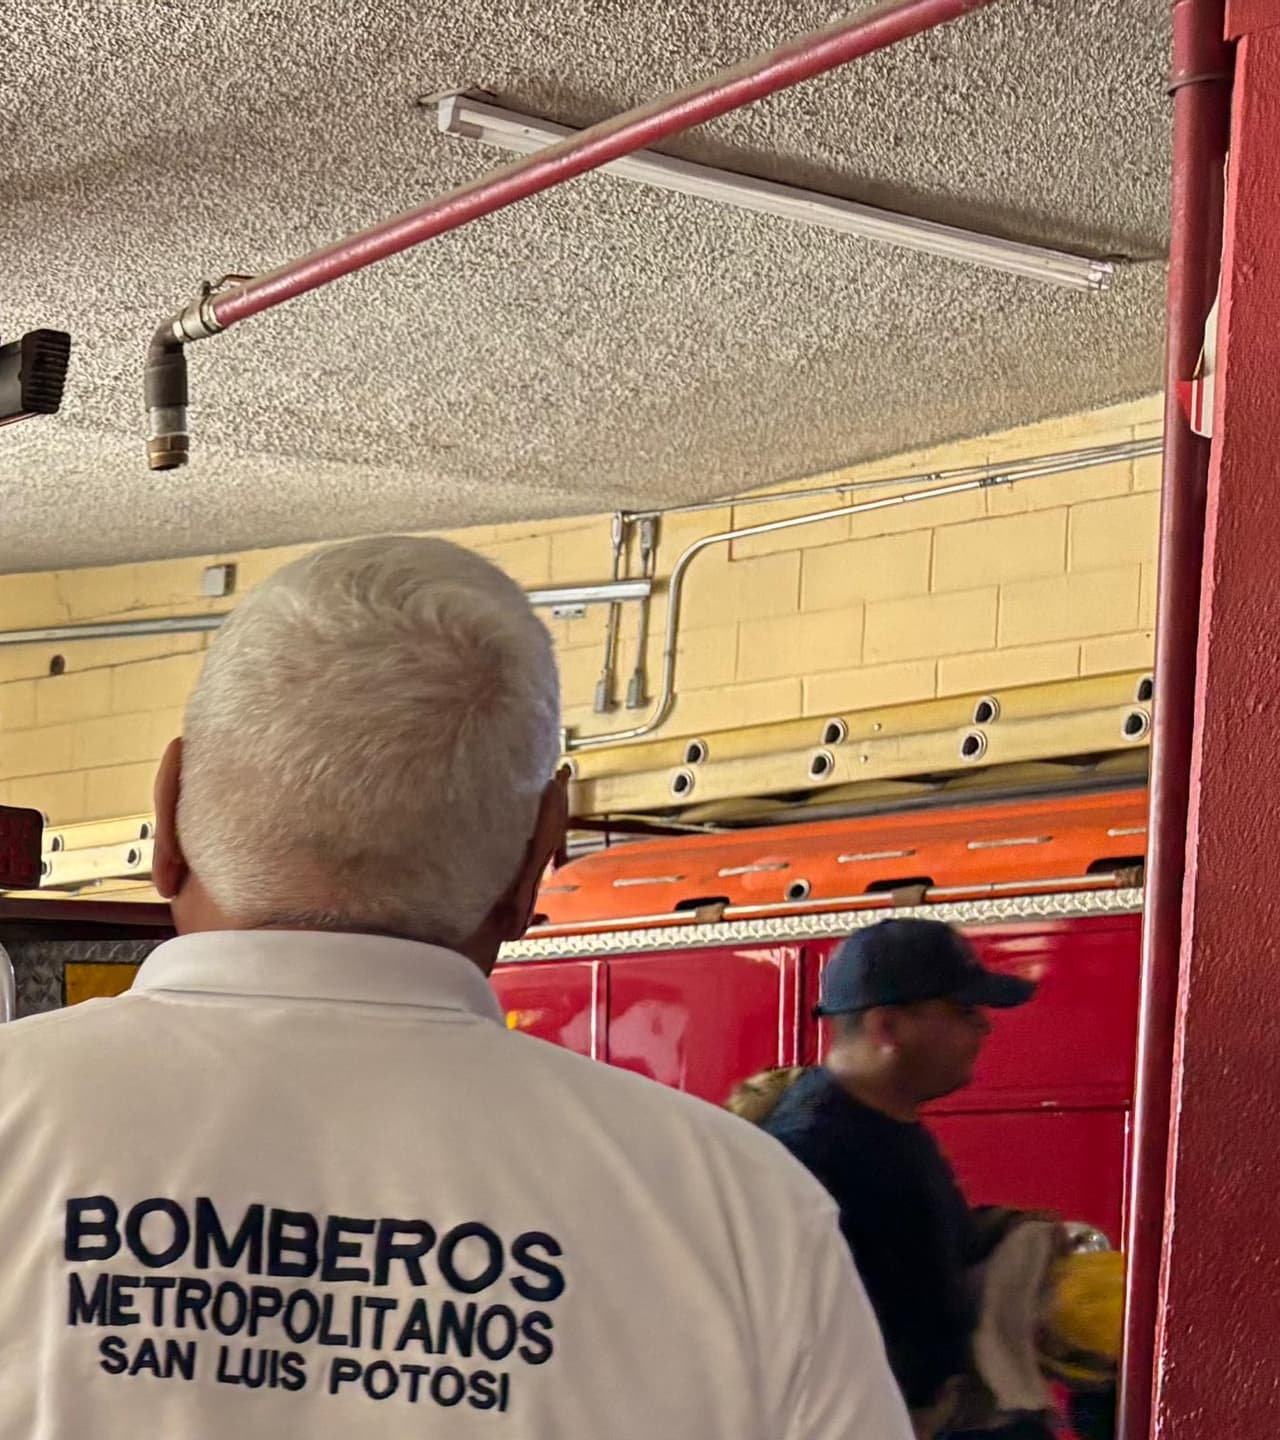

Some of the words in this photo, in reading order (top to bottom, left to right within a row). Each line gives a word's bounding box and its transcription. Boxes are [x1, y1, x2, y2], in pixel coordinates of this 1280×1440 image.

[64, 1195, 566, 1302] BOMBEROS
[67, 1273, 554, 1365] METROPOLITANOS
[99, 1336, 197, 1381] SAN
[216, 1346, 307, 1391] LUIS
[329, 1357, 510, 1413] POTOSI
